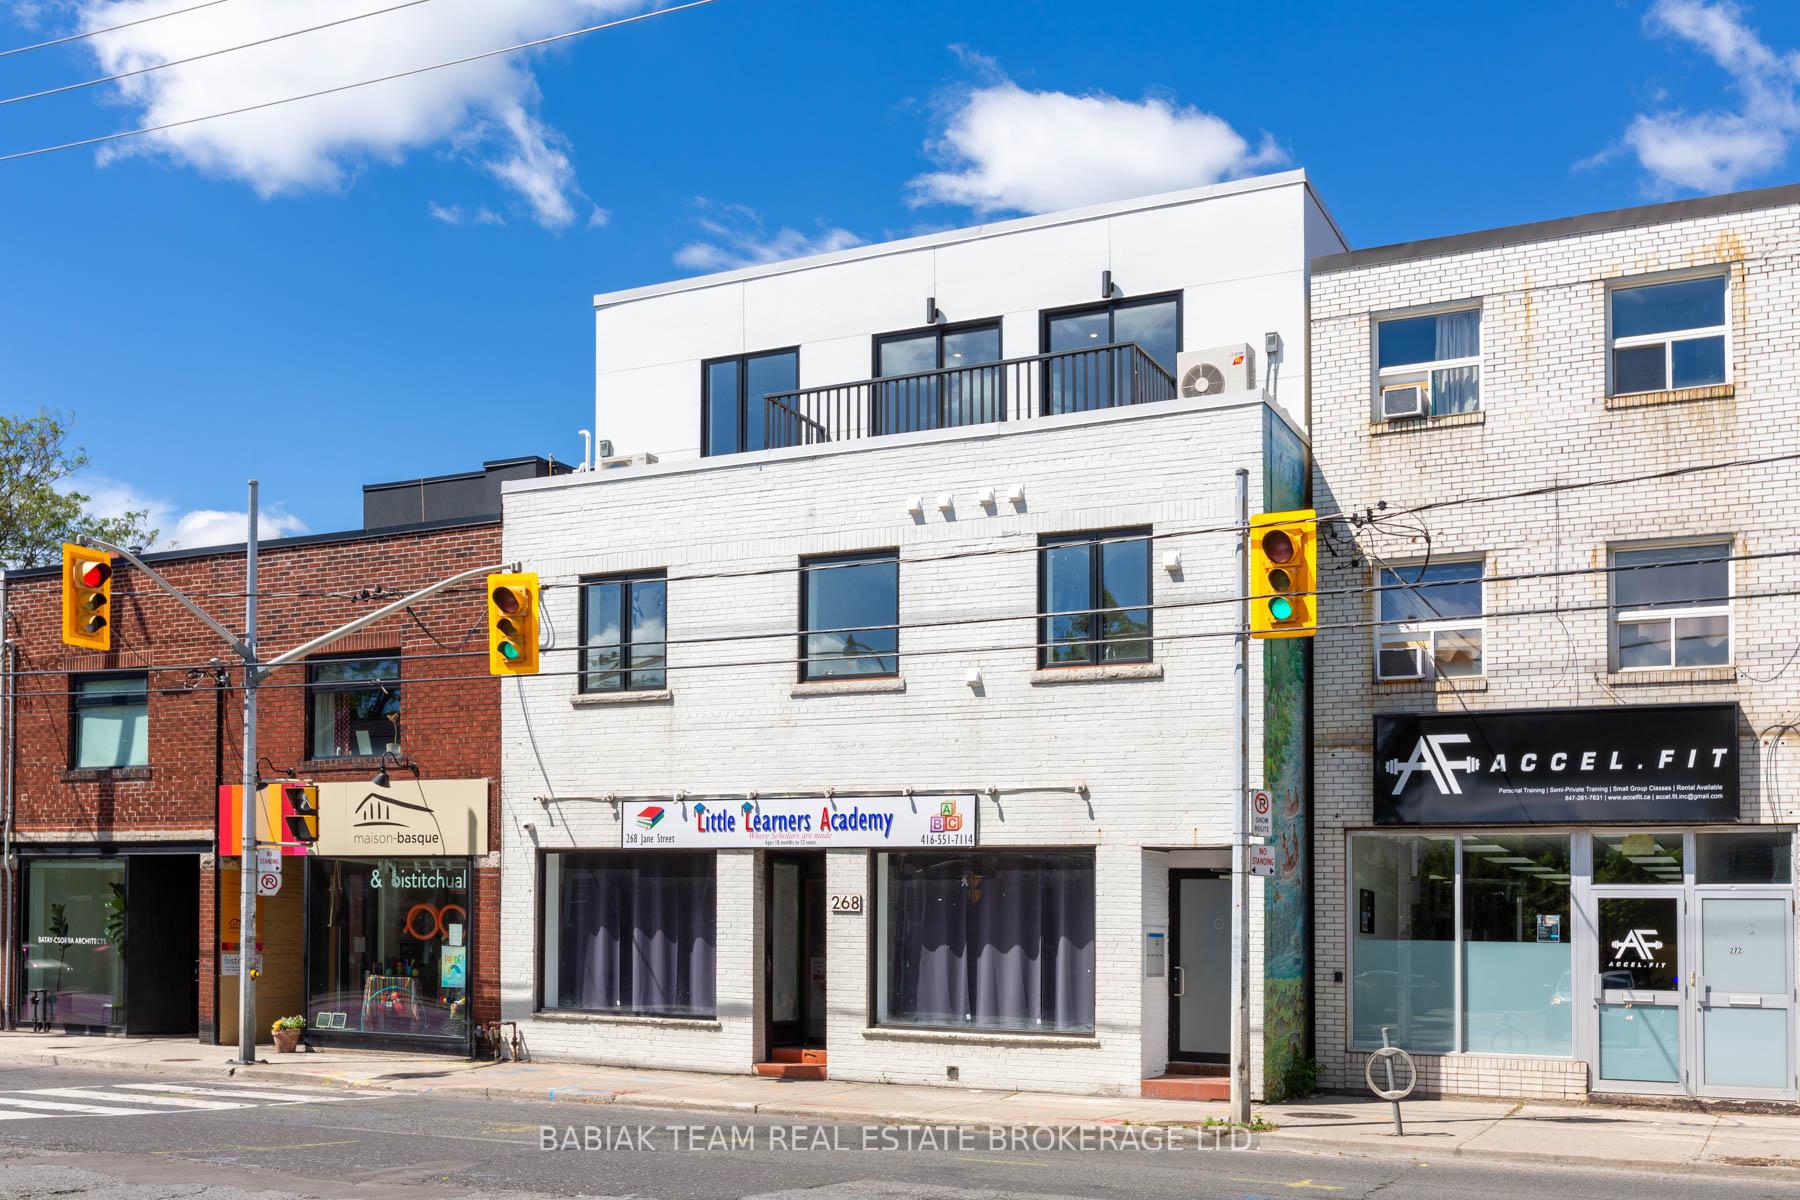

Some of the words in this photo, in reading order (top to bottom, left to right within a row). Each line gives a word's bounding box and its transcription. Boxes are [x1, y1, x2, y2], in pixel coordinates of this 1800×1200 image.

[1490, 748, 1728, 773] ACCEL.FIT
[1586, 786, 1608, 794] Training
[1630, 785, 1648, 793] Group
[698, 808, 736, 833] Little
[745, 811, 812, 833] Learners
[820, 806, 894, 839] Academy
[933, 818, 942, 830] B
[948, 818, 957, 829] C
[1254, 825, 1270, 833] ROUTE
[354, 831, 439, 846] maison-basque
[626, 833, 638, 843] 268
[640, 833, 654, 845] Jane
[656, 833, 675, 843] Street
[749, 831, 770, 839] Where
[771, 831, 800, 840] Scholars
[920, 834, 973, 845] 416-551-7114
[1259, 848, 1267, 856] NO
[1251, 857, 1274, 866] STANDING
[371, 869, 383, 888] &
[391, 868, 467, 889] bistitchual
[831, 895, 860, 910] 268
[1608, 961, 1667, 969] ACCEL.FIT
